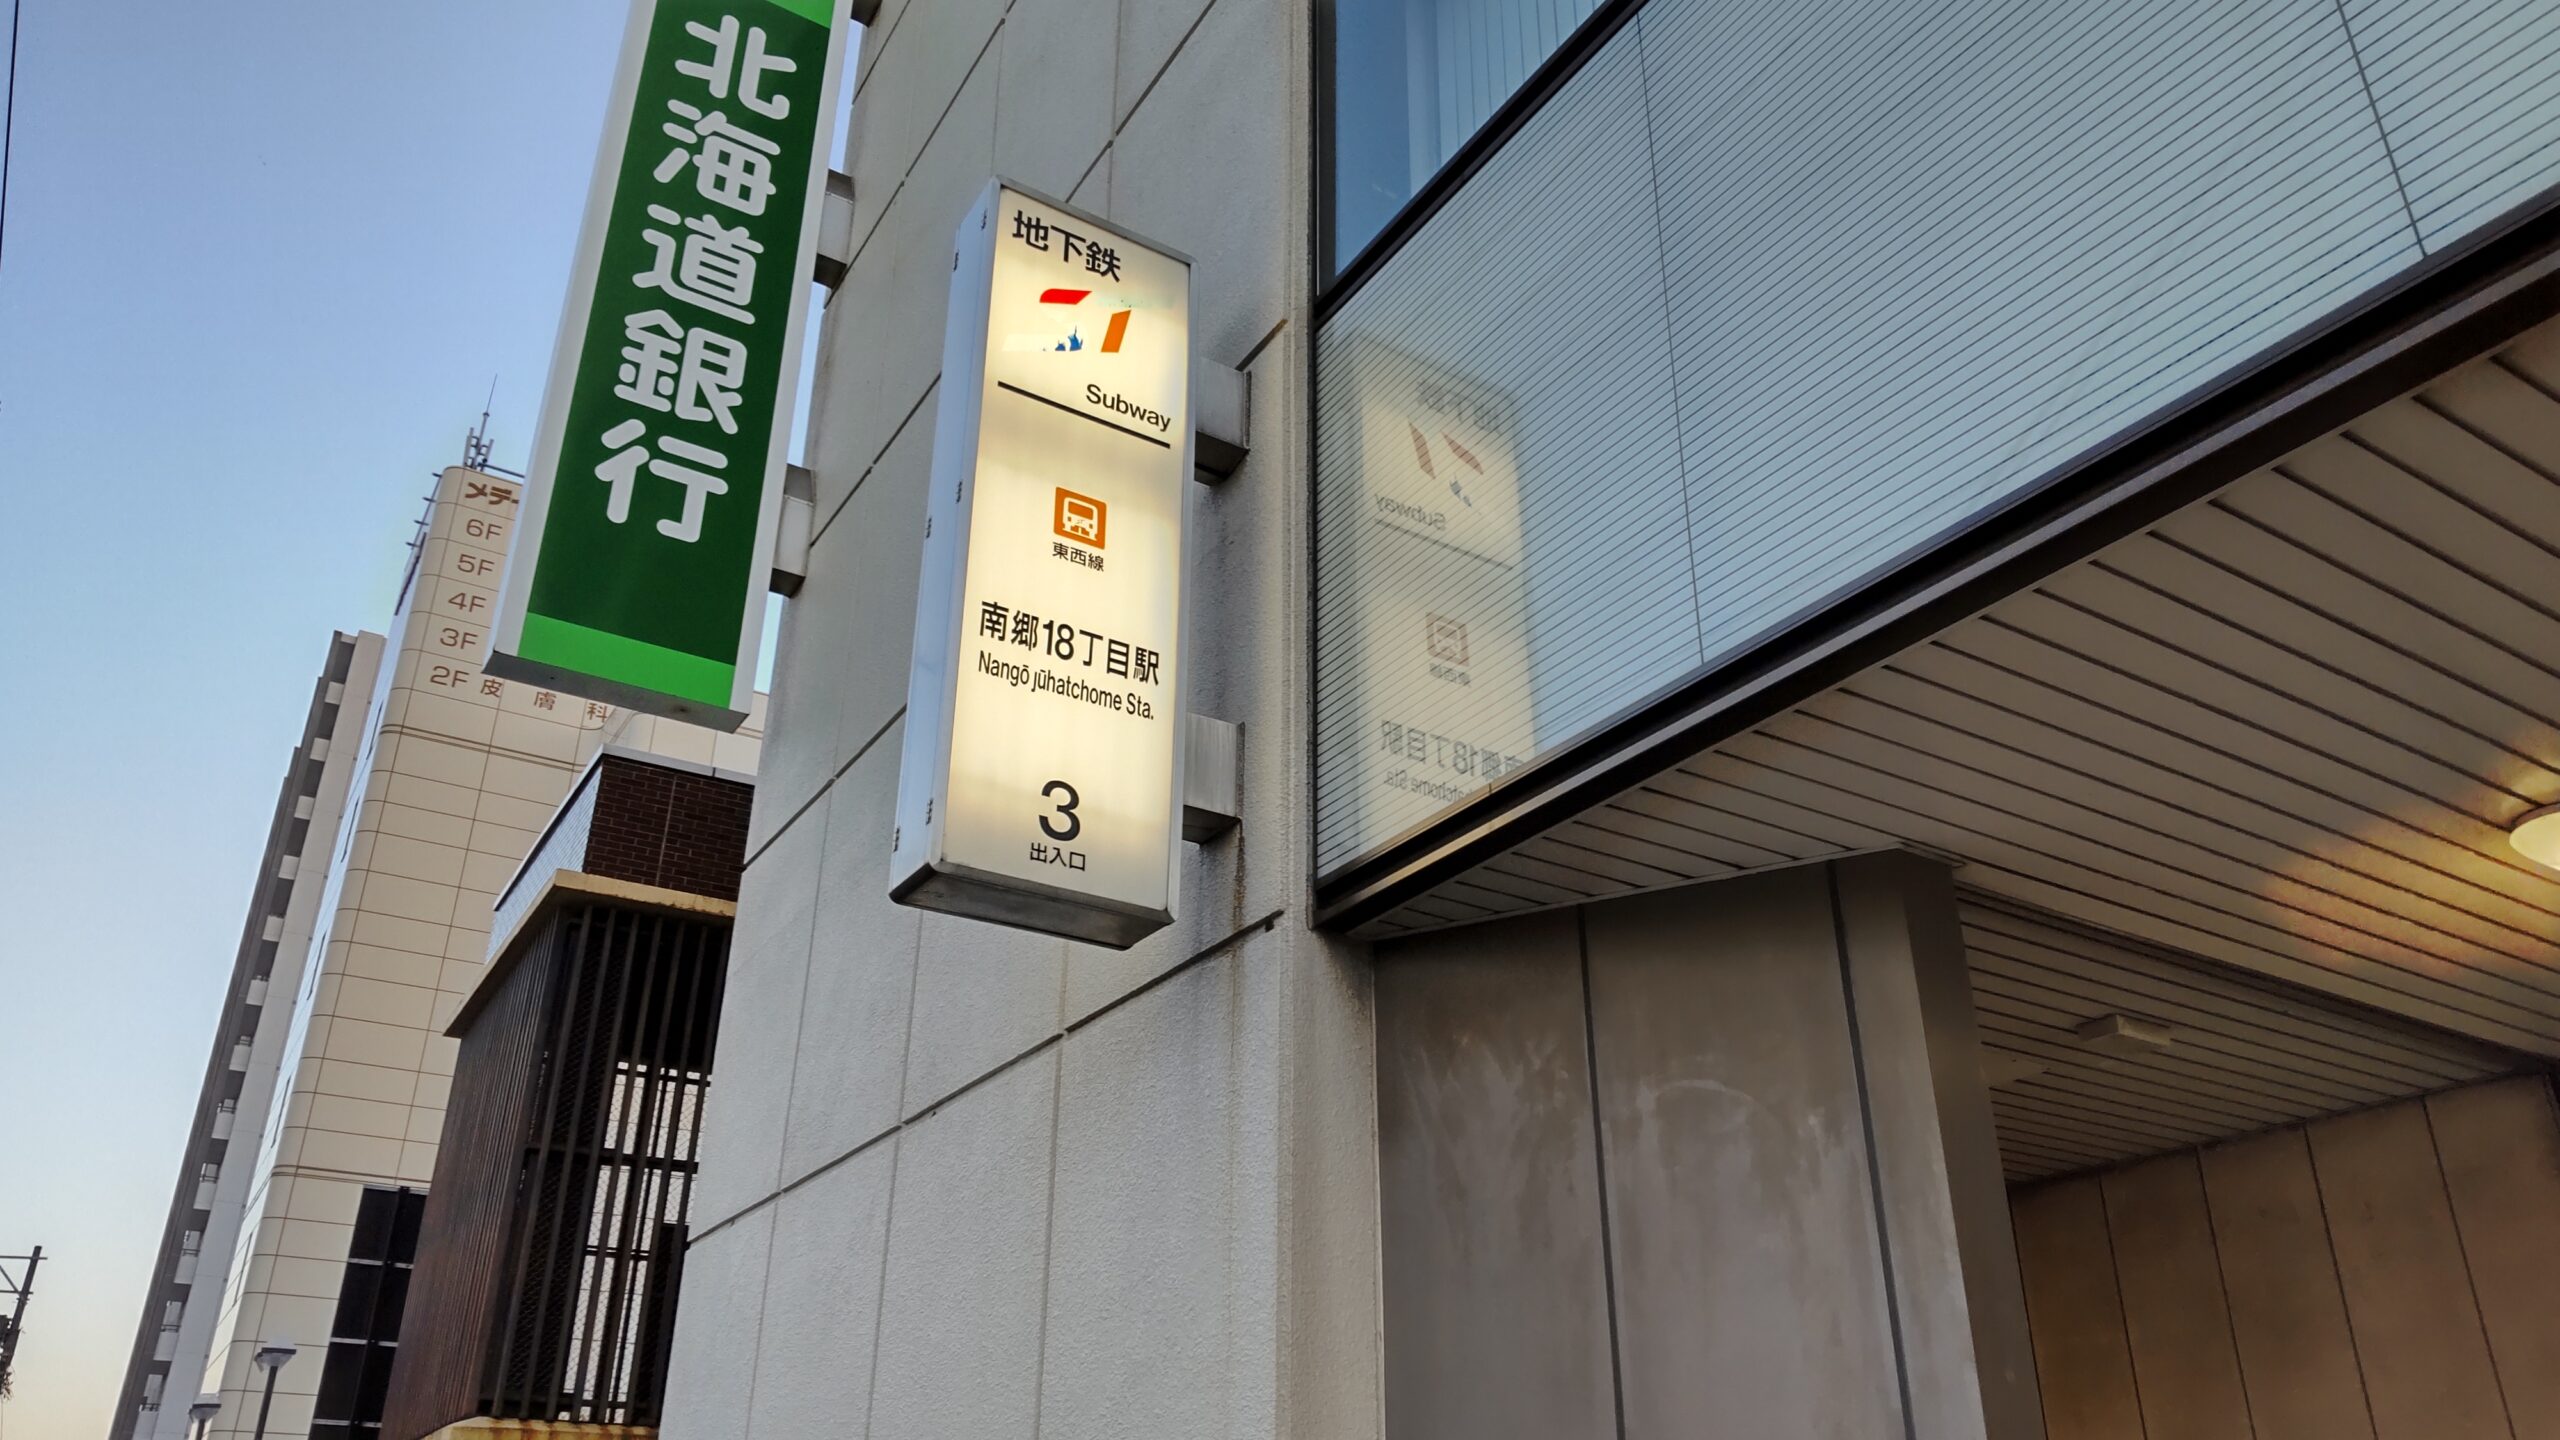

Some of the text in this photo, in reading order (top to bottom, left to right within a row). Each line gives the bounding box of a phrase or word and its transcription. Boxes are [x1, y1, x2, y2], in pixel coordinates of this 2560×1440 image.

[1012, 210, 1121, 282] 地下鉄
[595, 14, 798, 543] 北海道銀行
[1086, 384, 1171, 432] Subway
[466, 518, 503, 540] 6F
[457, 555, 495, 577] 5F
[1052, 541, 1104, 572] 東西線
[448, 592, 488, 613] 4F
[439, 628, 479, 650] 3F
[979, 600, 1160, 686] 南郷18丁目駅
[430, 665, 470, 688] 2F
[978, 650, 1154, 720] Nangō jūhatchome Sta.
[1038, 780, 1081, 841] 3
[1029, 842, 1086, 872] 出入口
